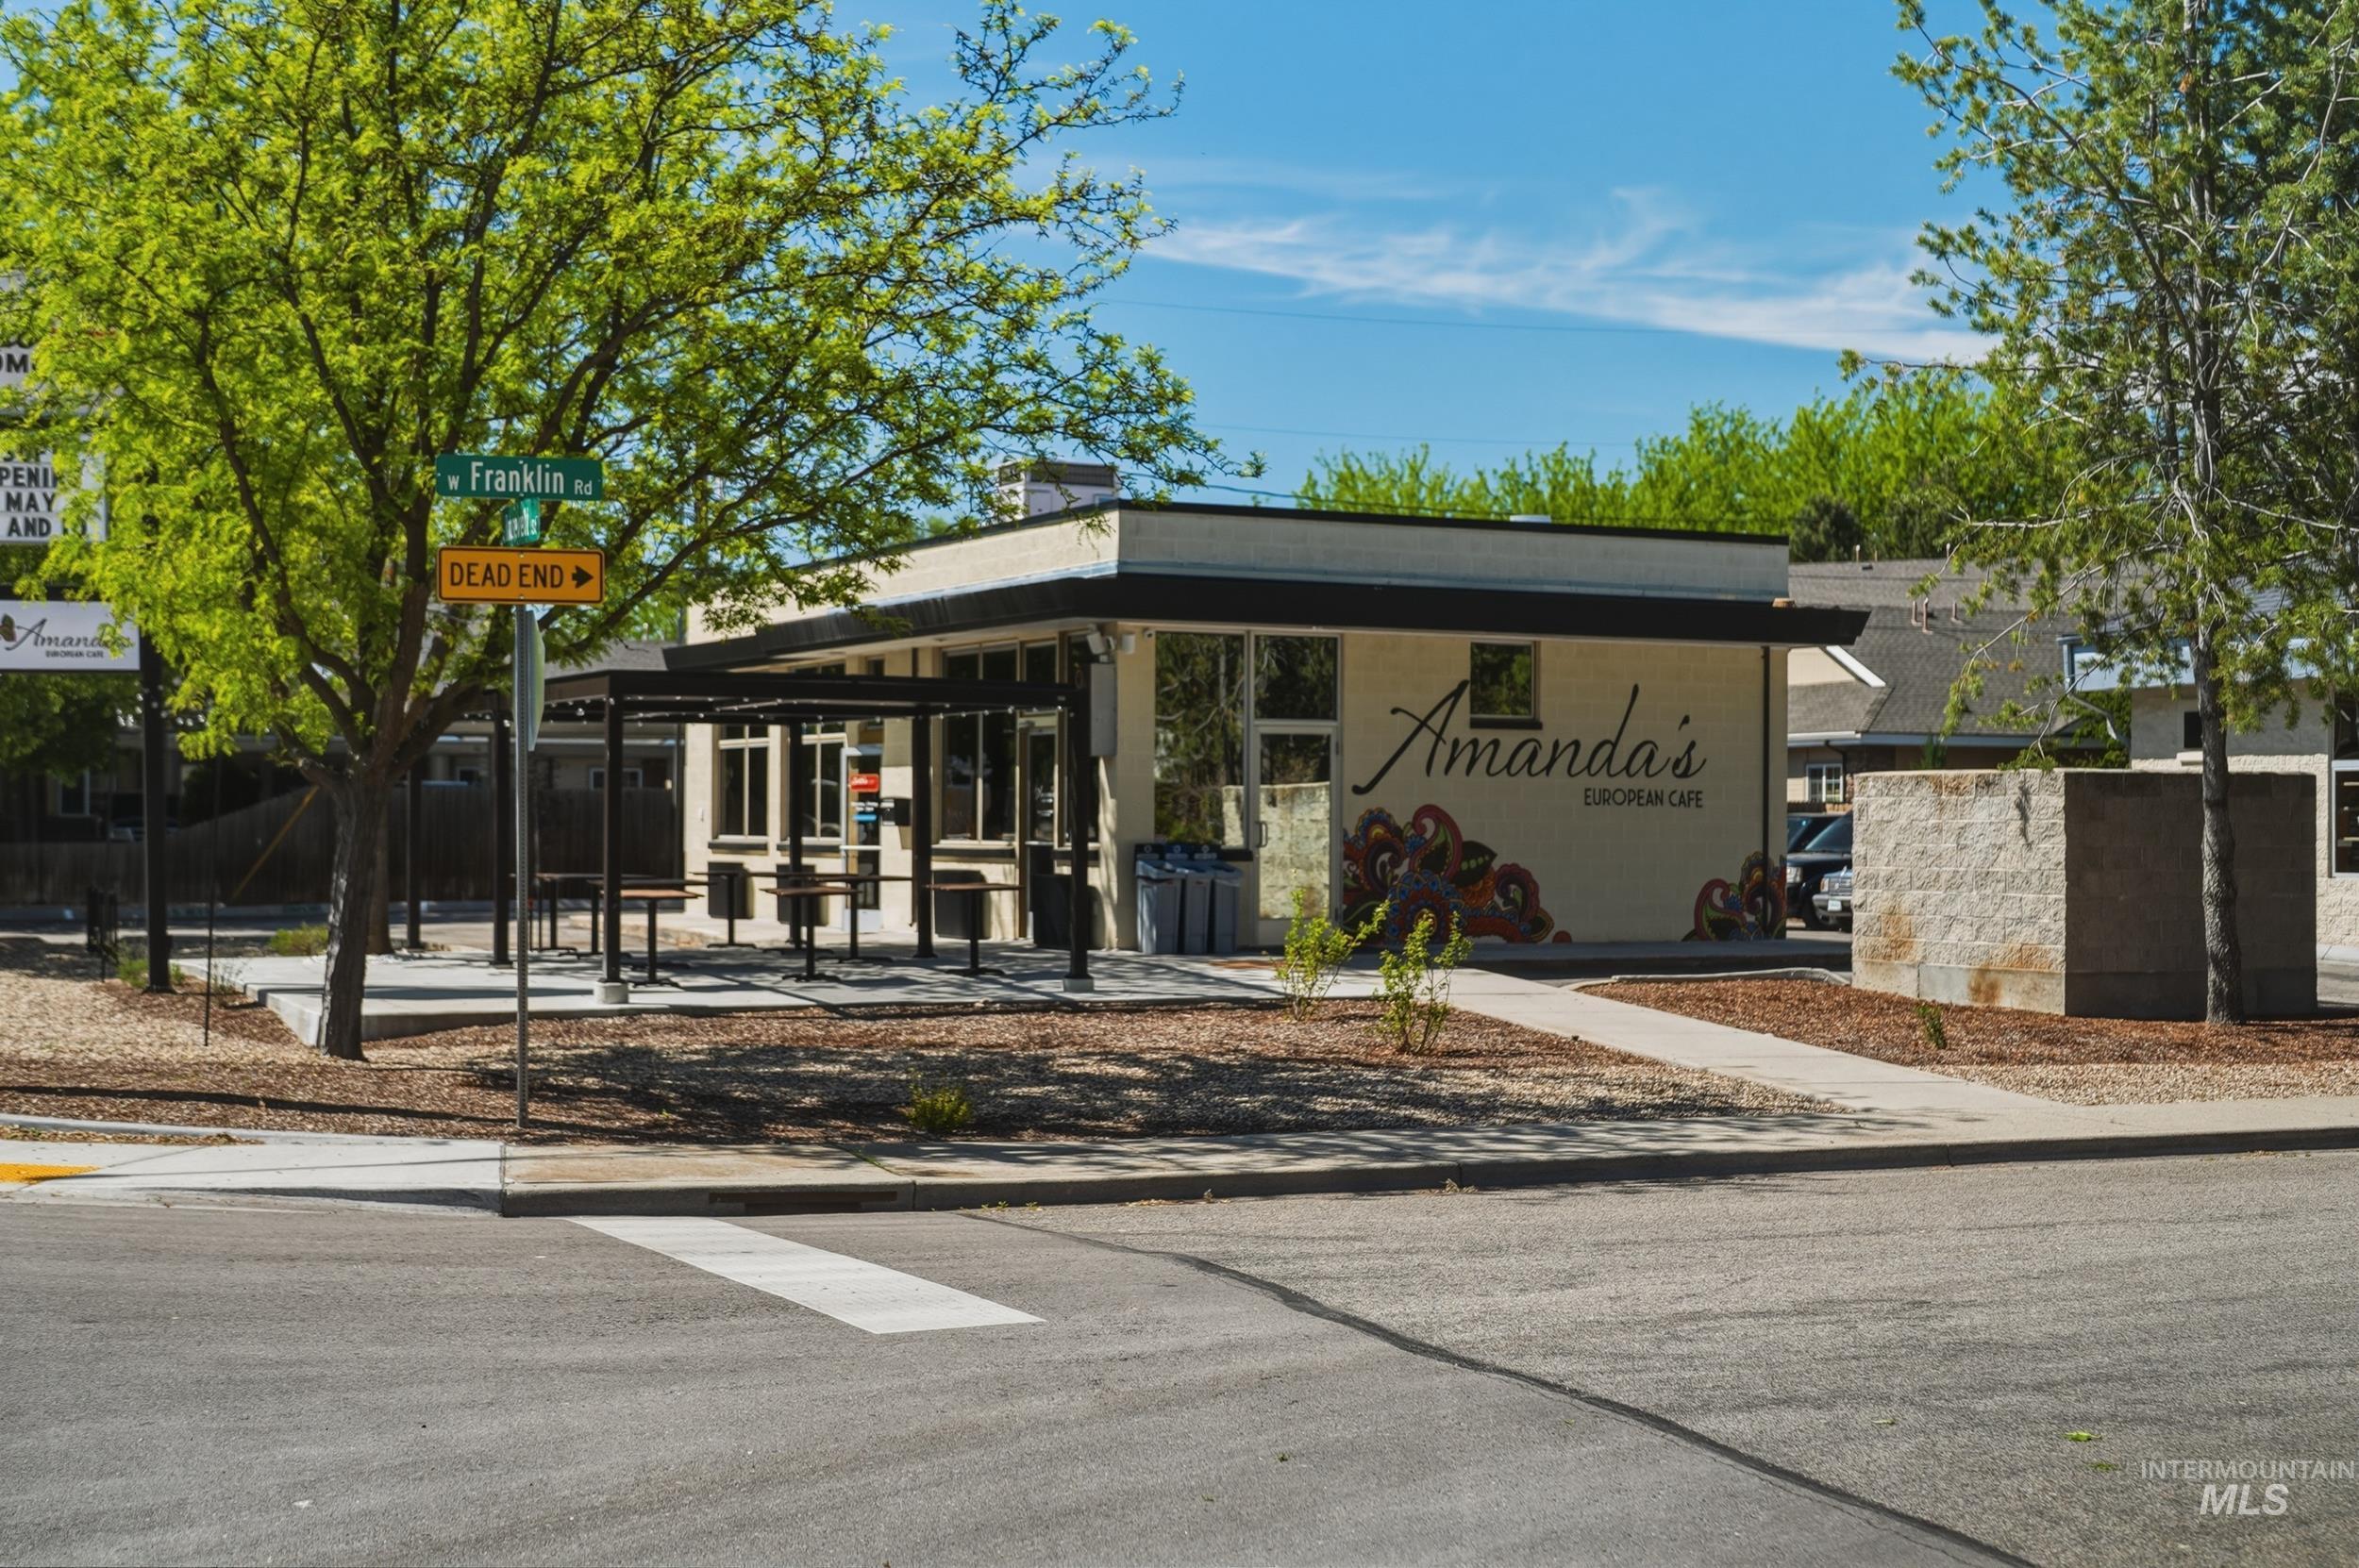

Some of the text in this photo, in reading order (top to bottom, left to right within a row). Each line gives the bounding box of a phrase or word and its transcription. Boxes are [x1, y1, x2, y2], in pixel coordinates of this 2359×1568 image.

[447, 461, 593, 495] W Franklin Rd
[6, 492, 55, 512] MAY
[8, 517, 52, 537] AND
[450, 562, 564, 588] DEAD END
[1351, 679, 1707, 795] Amanda's
[1584, 788, 1703, 809] EUROPEAN CAFE
